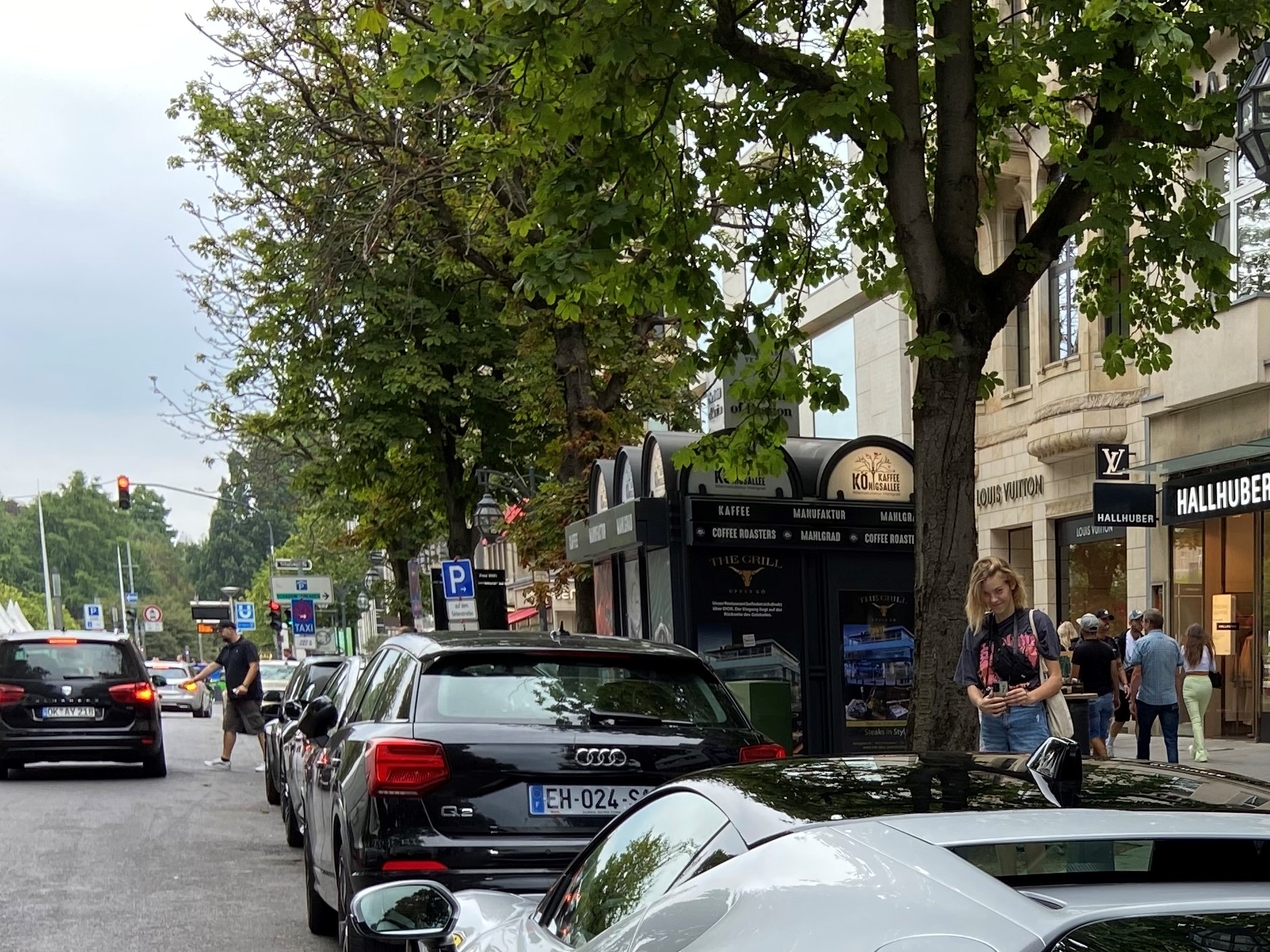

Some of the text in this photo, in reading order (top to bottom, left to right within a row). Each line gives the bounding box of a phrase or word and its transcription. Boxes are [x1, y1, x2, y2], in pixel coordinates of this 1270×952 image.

[878, 473, 900, 483] KAFFEE
[976, 475, 1044, 508] LOUIS VUITTON
[718, 505, 750, 517] KAFFEE
[793, 507, 846, 520] MANUFAKTUR
[1097, 513, 1154, 523] HALLHUBER
[712, 527, 777, 540] COFFEE ROASTERS
[800, 530, 841, 542] MAHLGRAD
[1076, 526, 1091, 538] LOUIS
[864, 533, 889, 544] COFFEE
[709, 555, 783, 568] THE GRILL
[449, 565, 466, 594] P
[295, 623, 314, 632] TAXI
[441, 806, 474, 817] Q2
